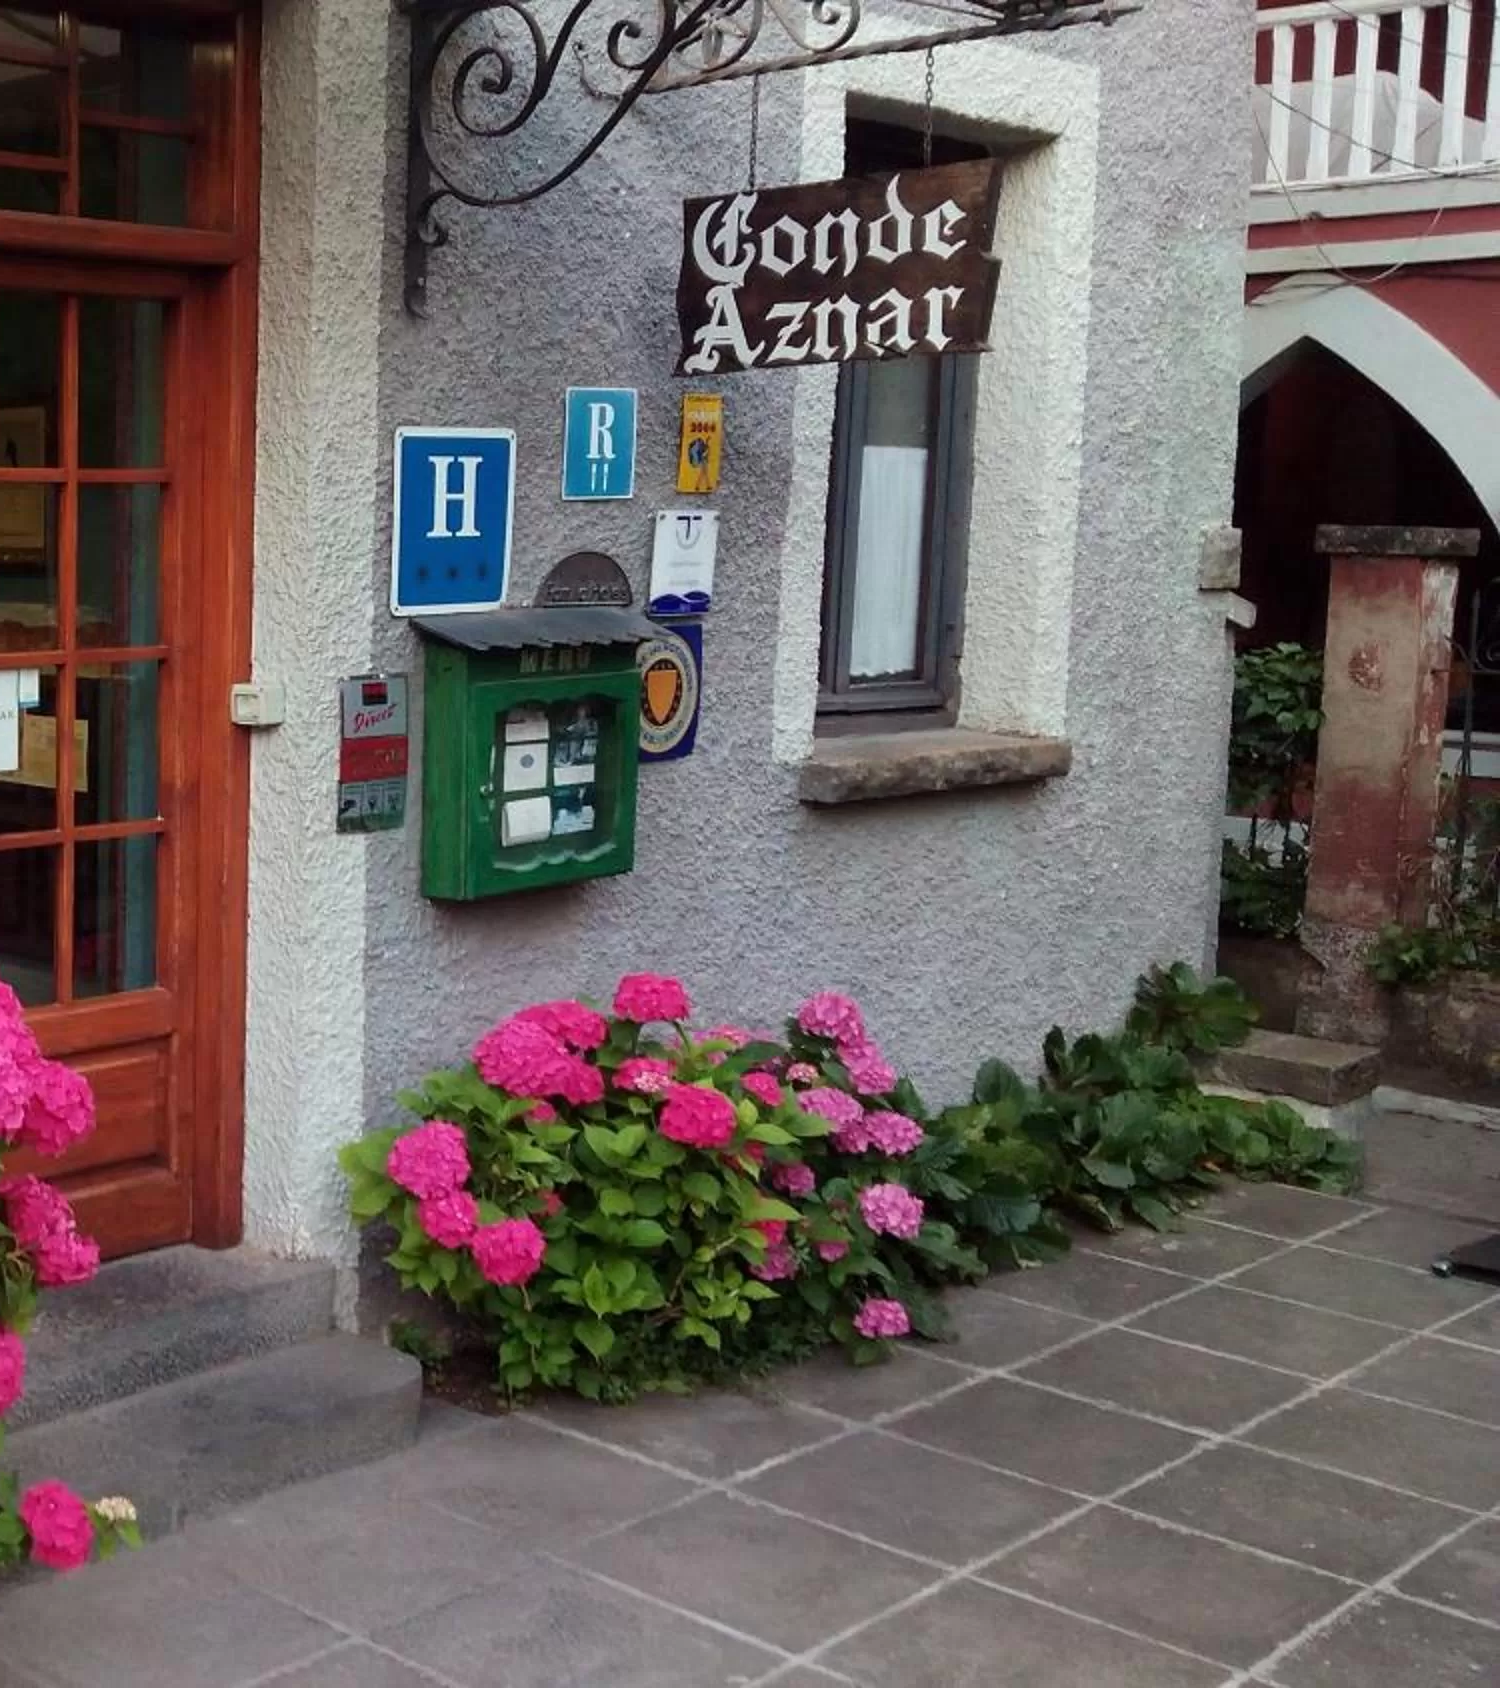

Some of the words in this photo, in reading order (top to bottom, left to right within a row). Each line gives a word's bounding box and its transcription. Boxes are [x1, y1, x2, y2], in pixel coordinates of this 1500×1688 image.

[693, 173, 967, 285] Conde
[683, 285, 965, 374] Aznar
[586, 403, 616, 459] R
[426, 456, 482, 537] H
